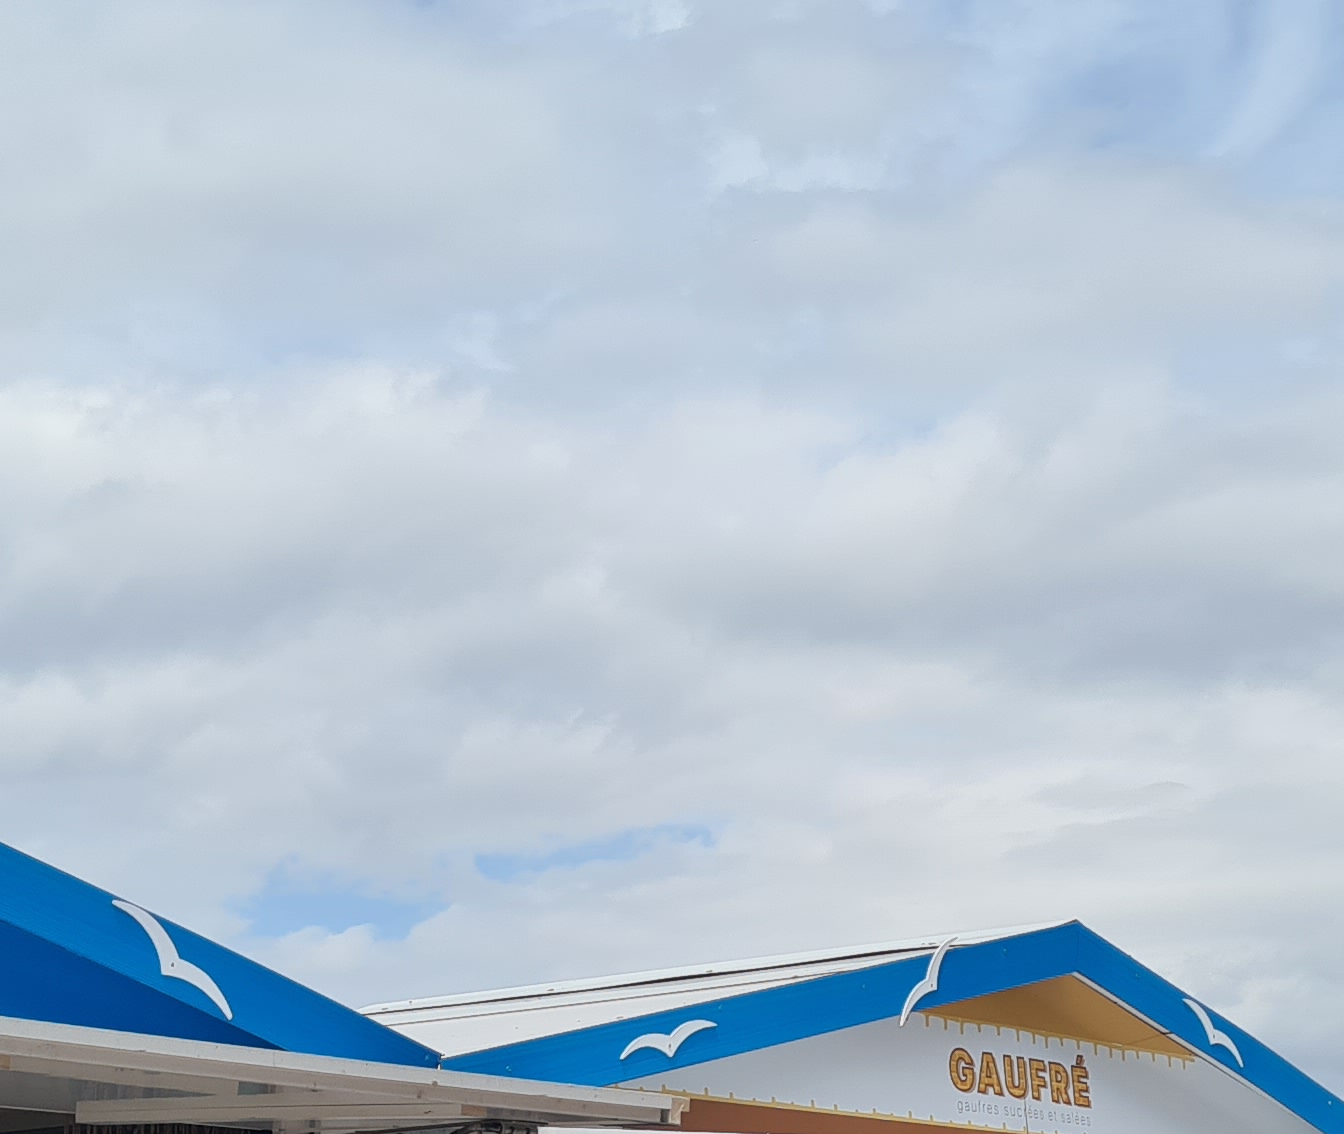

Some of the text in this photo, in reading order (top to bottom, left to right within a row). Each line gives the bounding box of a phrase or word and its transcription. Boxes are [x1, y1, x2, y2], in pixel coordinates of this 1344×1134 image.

[949, 1048, 1092, 1108] GAUFRÉ
[957, 1100, 1091, 1127] gaufres sucrées et salées
